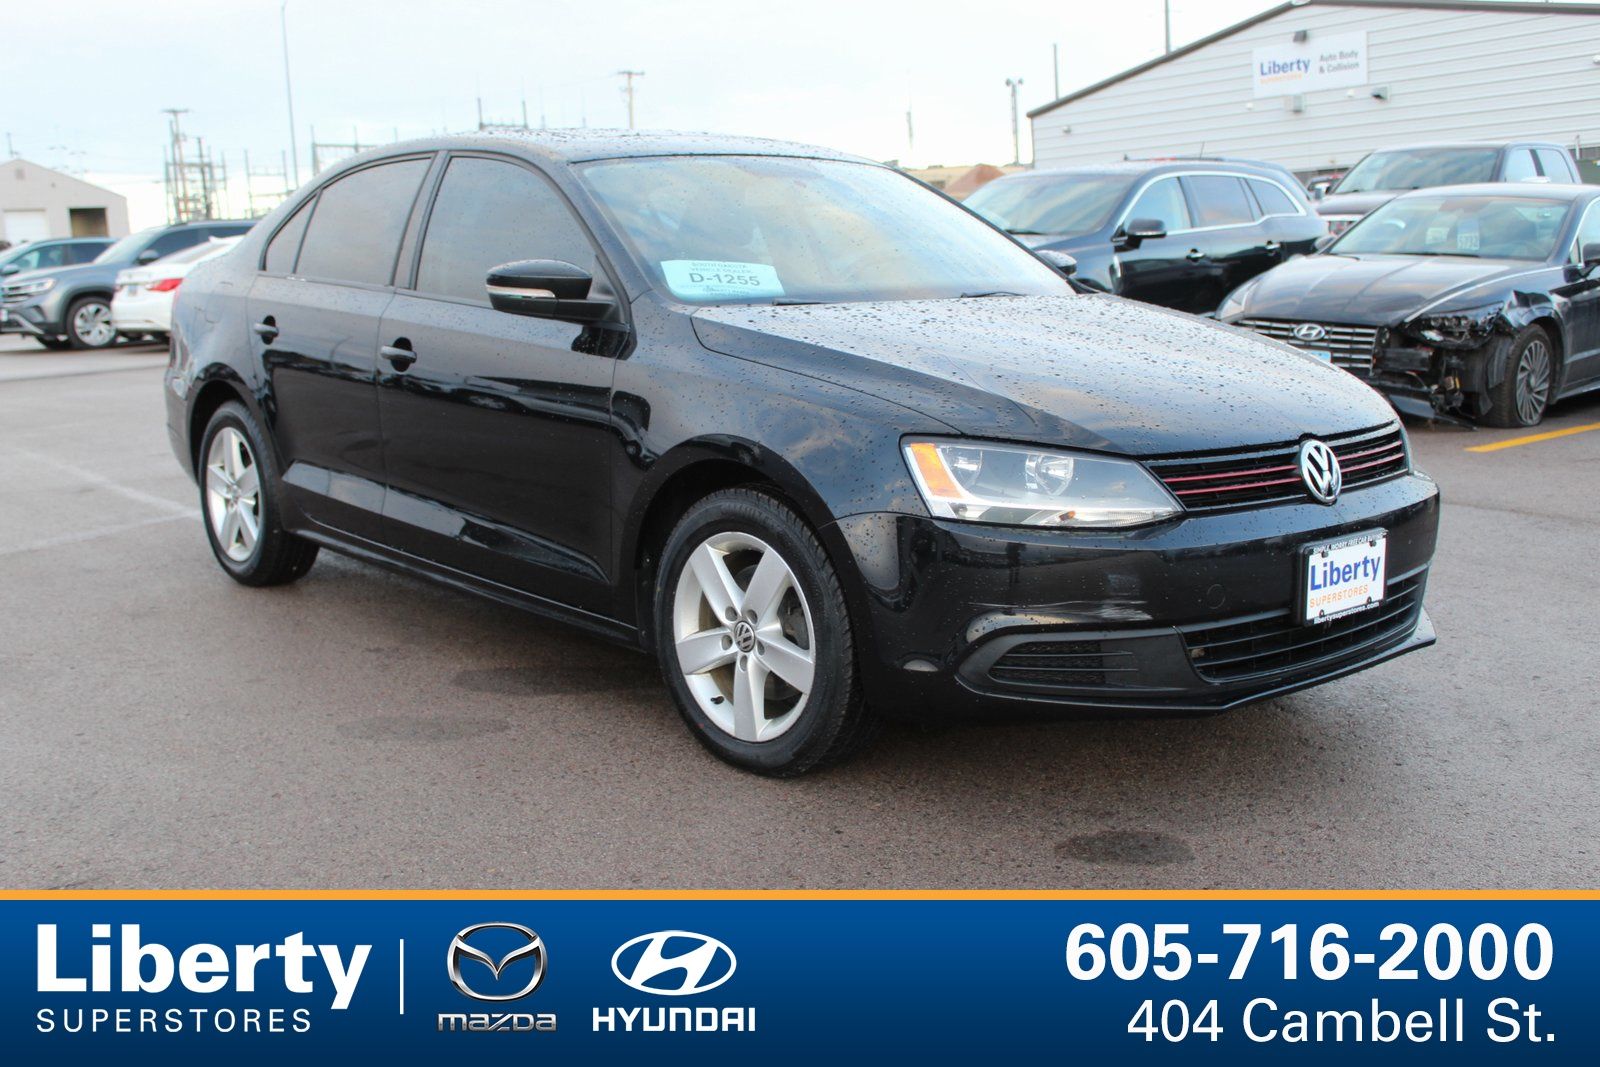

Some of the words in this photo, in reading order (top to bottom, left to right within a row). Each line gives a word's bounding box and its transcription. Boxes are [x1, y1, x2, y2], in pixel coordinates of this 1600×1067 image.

[1260, 58, 1311, 76] Liberty
[1326, 61, 1360, 73] Collision
[689, 272, 761, 287] D-1255
[1310, 556, 1381, 591] Liberty
[1309, 585, 1369, 608] SUPERSTORES
[1314, 602, 1380, 625] libertysuperstores.com
